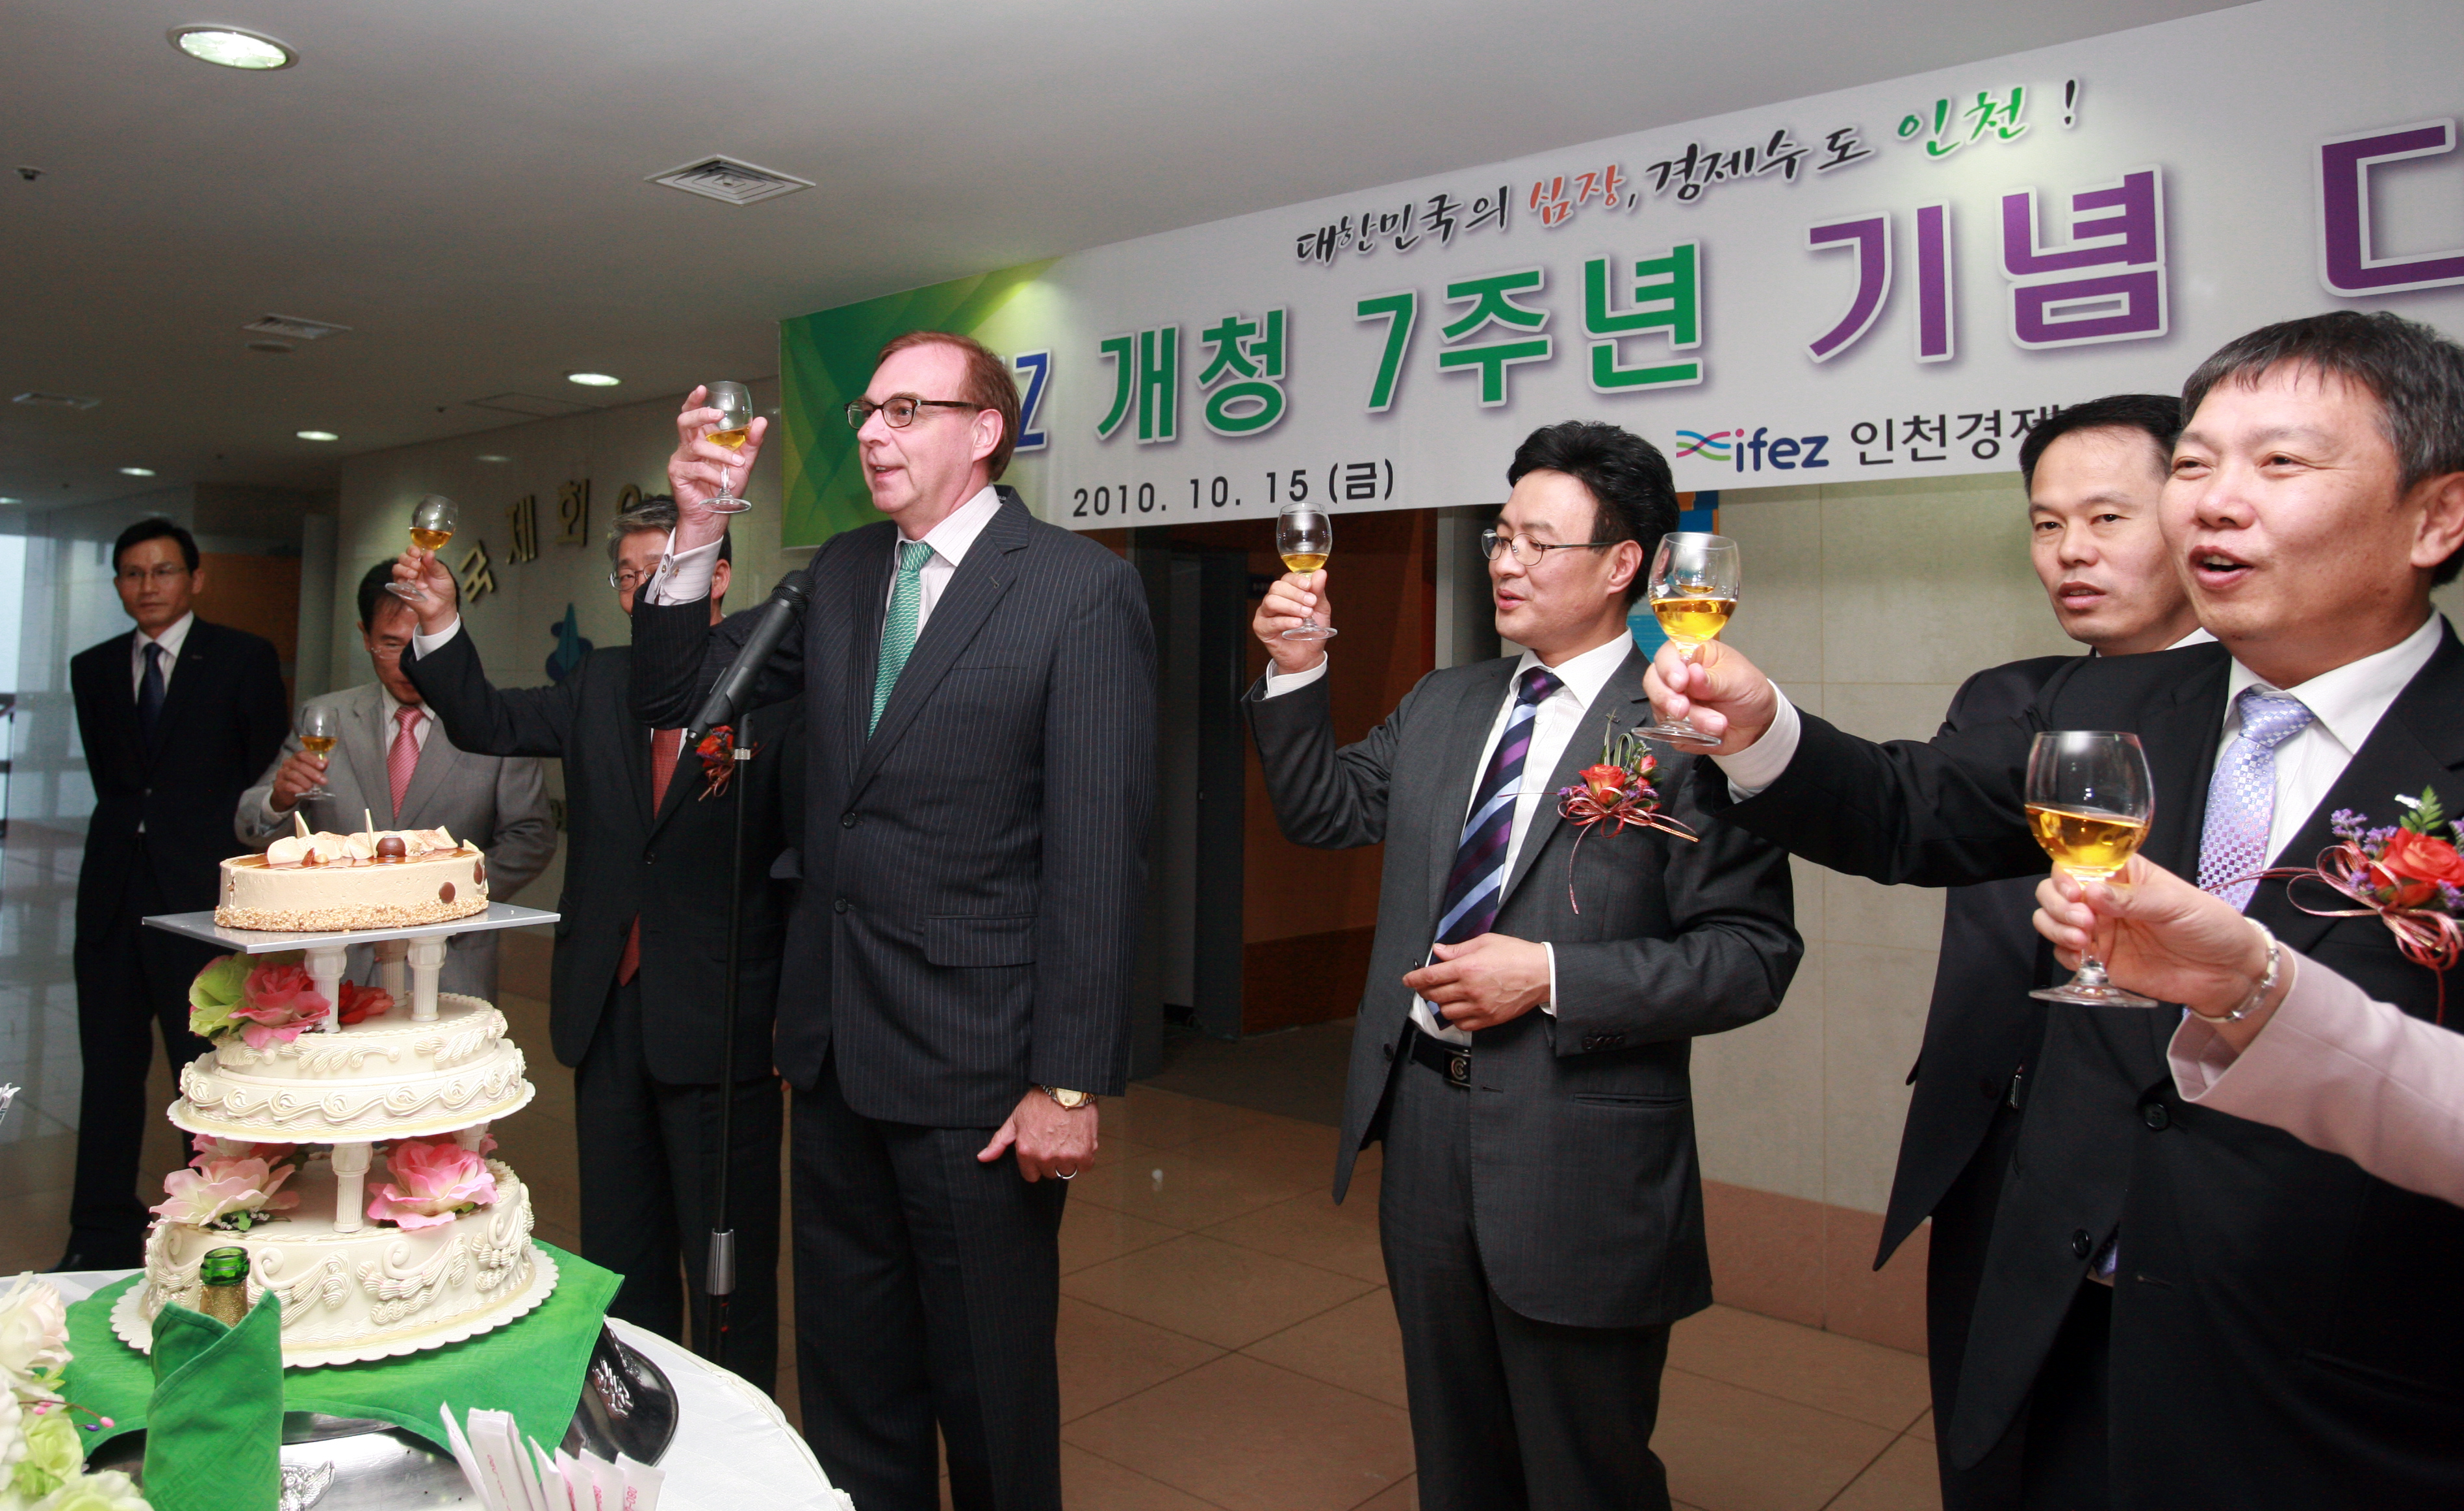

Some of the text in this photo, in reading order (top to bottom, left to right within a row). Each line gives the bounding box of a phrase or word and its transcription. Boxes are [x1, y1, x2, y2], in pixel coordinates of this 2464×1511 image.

[1296, 186, 1508, 262] 대한민국의
[1530, 164, 1636, 225] 심장,
[1897, 86, 2029, 156] 인천
[1097, 309, 1283, 441] 개청
[1357, 244, 1697, 407] 7주년
[1809, 171, 2161, 357] 기념
[1073, 458, 1393, 517] 2010. 10. 15 (금)
[1735, 426, 1829, 472] ifez
